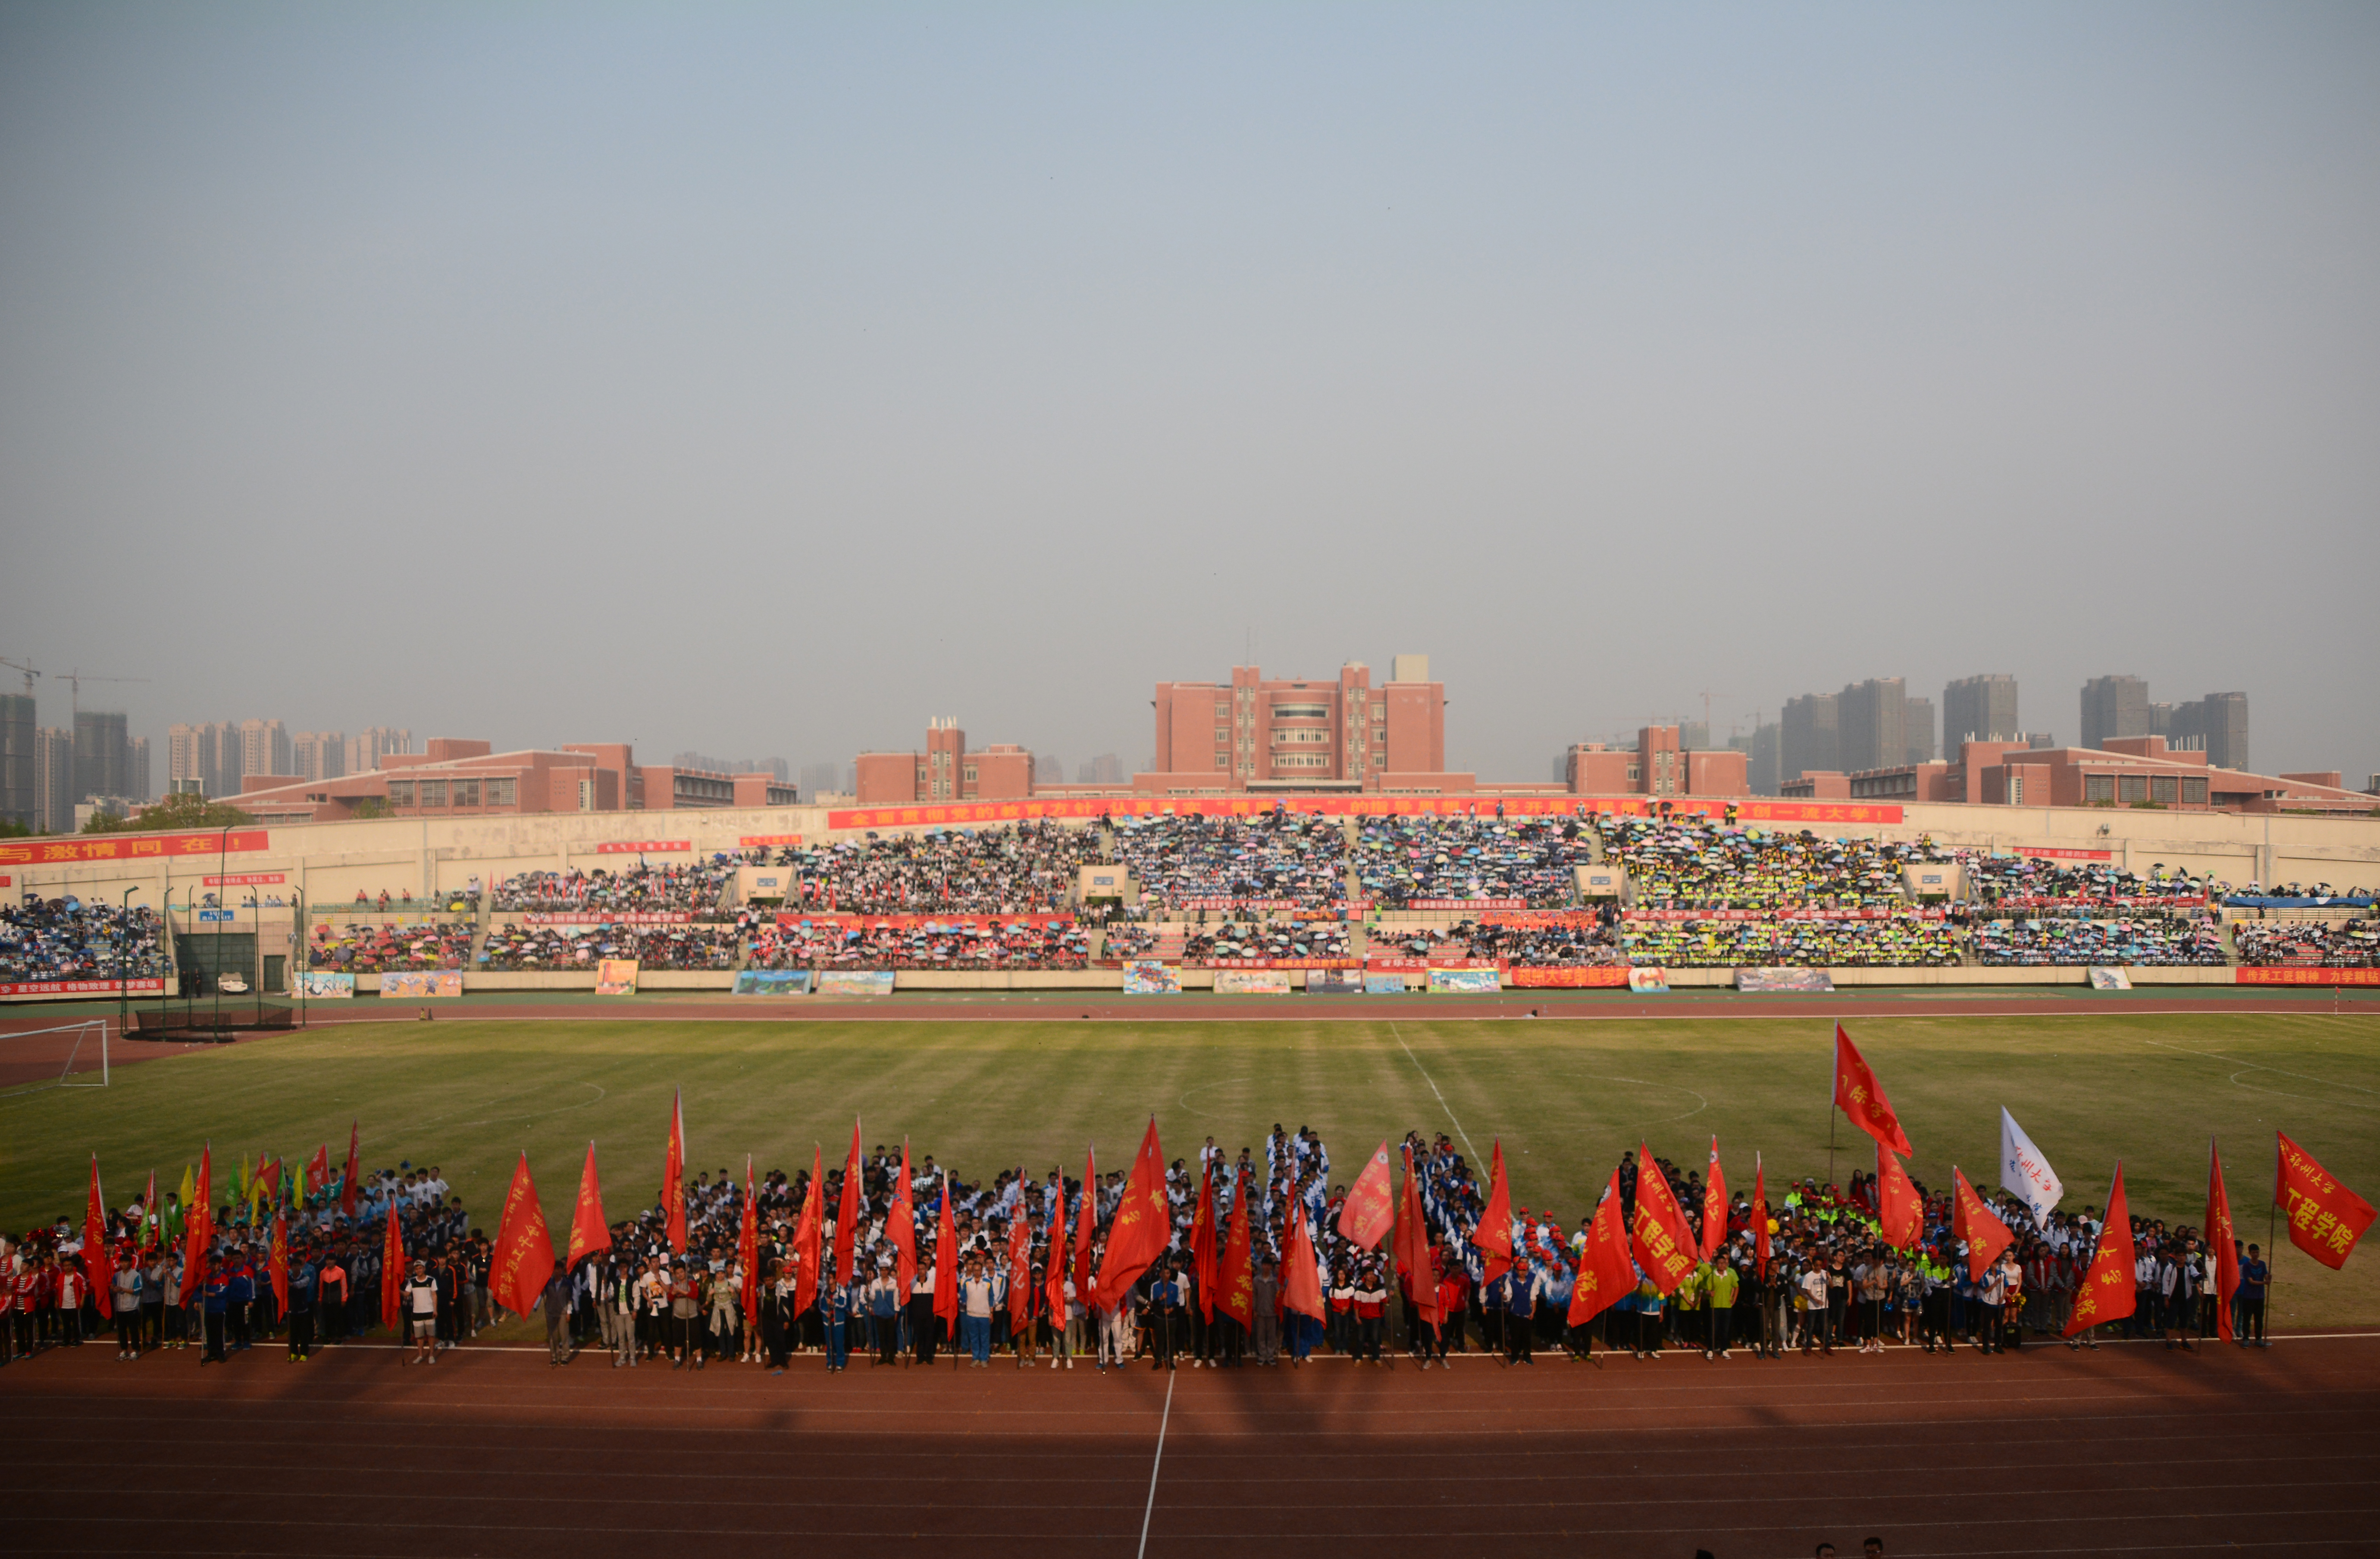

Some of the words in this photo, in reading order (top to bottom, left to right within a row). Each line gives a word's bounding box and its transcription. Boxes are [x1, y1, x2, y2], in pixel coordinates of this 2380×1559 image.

[850, 802, 1094, 826] 全面贯彻党的教育方针
[18, 983, 61, 993] 星空远航
[67, 981, 110, 991] 格物致理
[2247, 970, 2319, 983] 传承工匠精神
[1642, 1169, 1673, 1212] 郑州大学
[2289, 1152, 2336, 1194] 郑州大学
[1635, 1199, 1689, 1277] 工程学院
[2286, 1183, 2354, 1255] 工程学院
